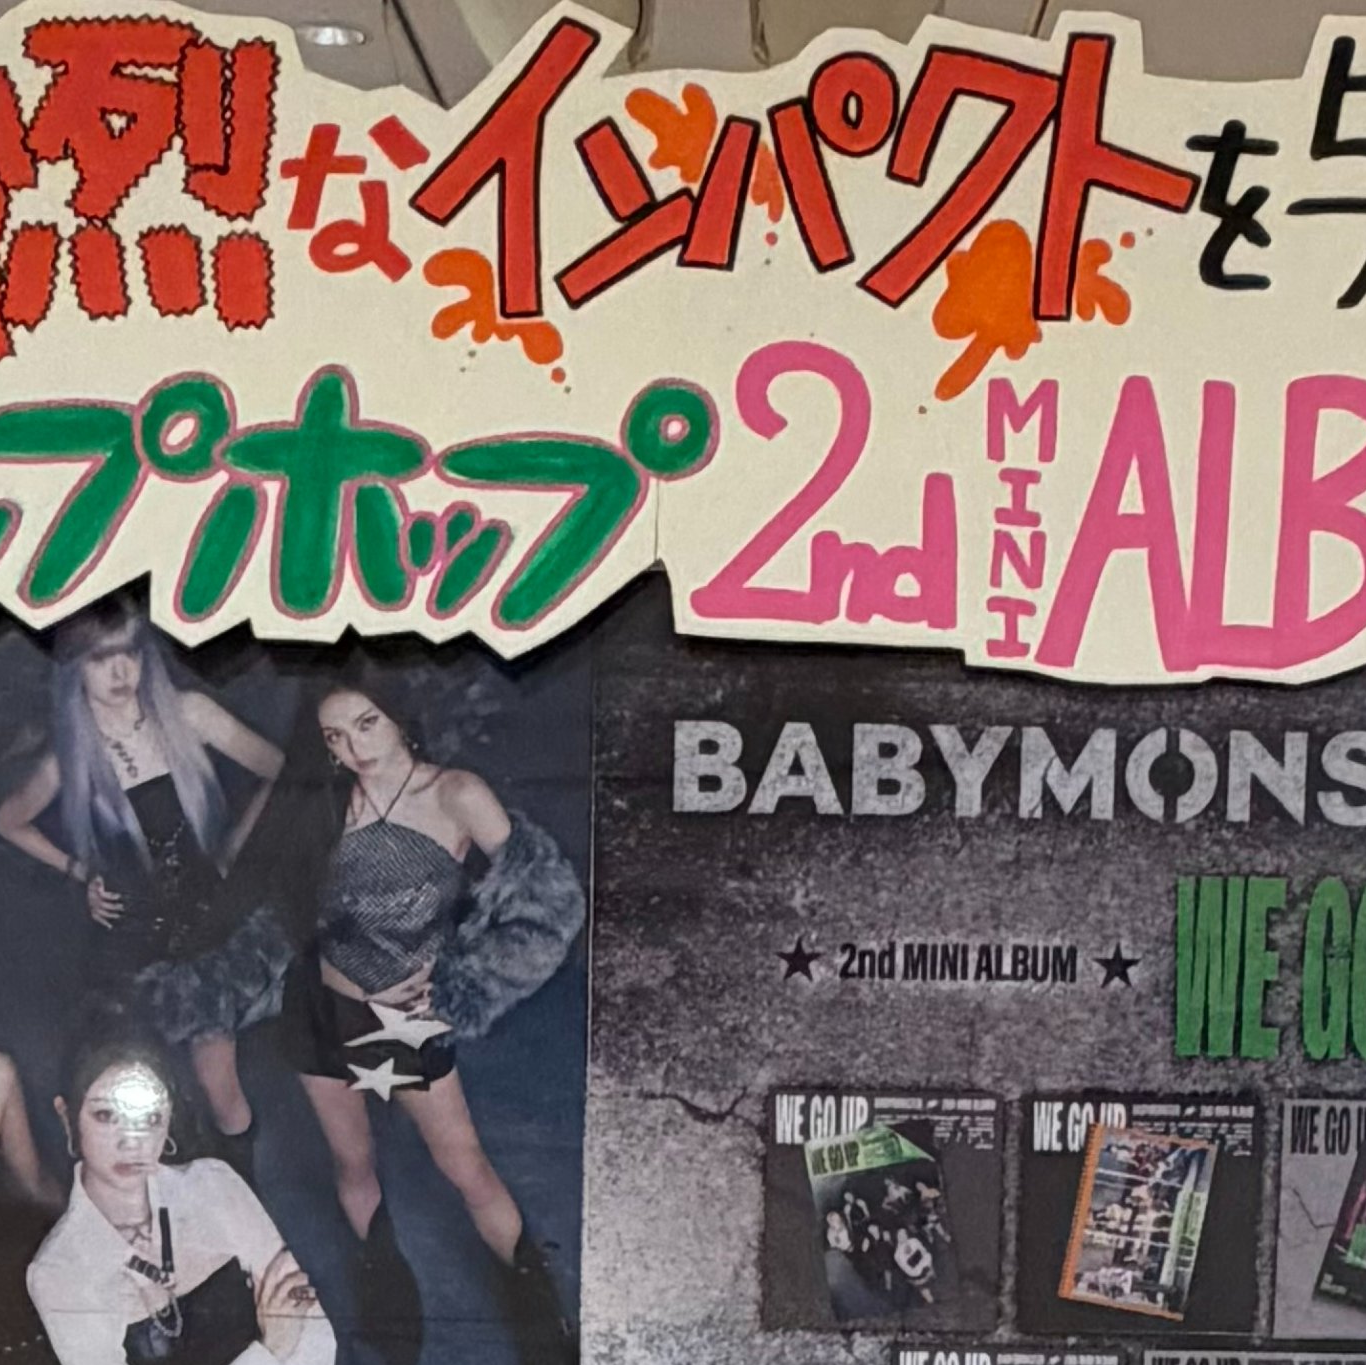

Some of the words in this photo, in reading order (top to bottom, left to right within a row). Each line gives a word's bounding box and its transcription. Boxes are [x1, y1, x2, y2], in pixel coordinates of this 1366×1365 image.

[693, 341, 956, 634] 2nd
[985, 377, 1057, 662] MINI
[838, 942, 897, 982] 2nd
[901, 943, 970, 983] MINI
[975, 944, 1078, 986] ALBUM
[1175, 876, 1288, 1061] WE
[776, 1094, 806, 1145] WE
[810, 1095, 837, 1142] GO
[1034, 1101, 1064, 1152] WE
[1291, 1105, 1321, 1155] WE
[1325, 1105, 1352, 1156] GO
